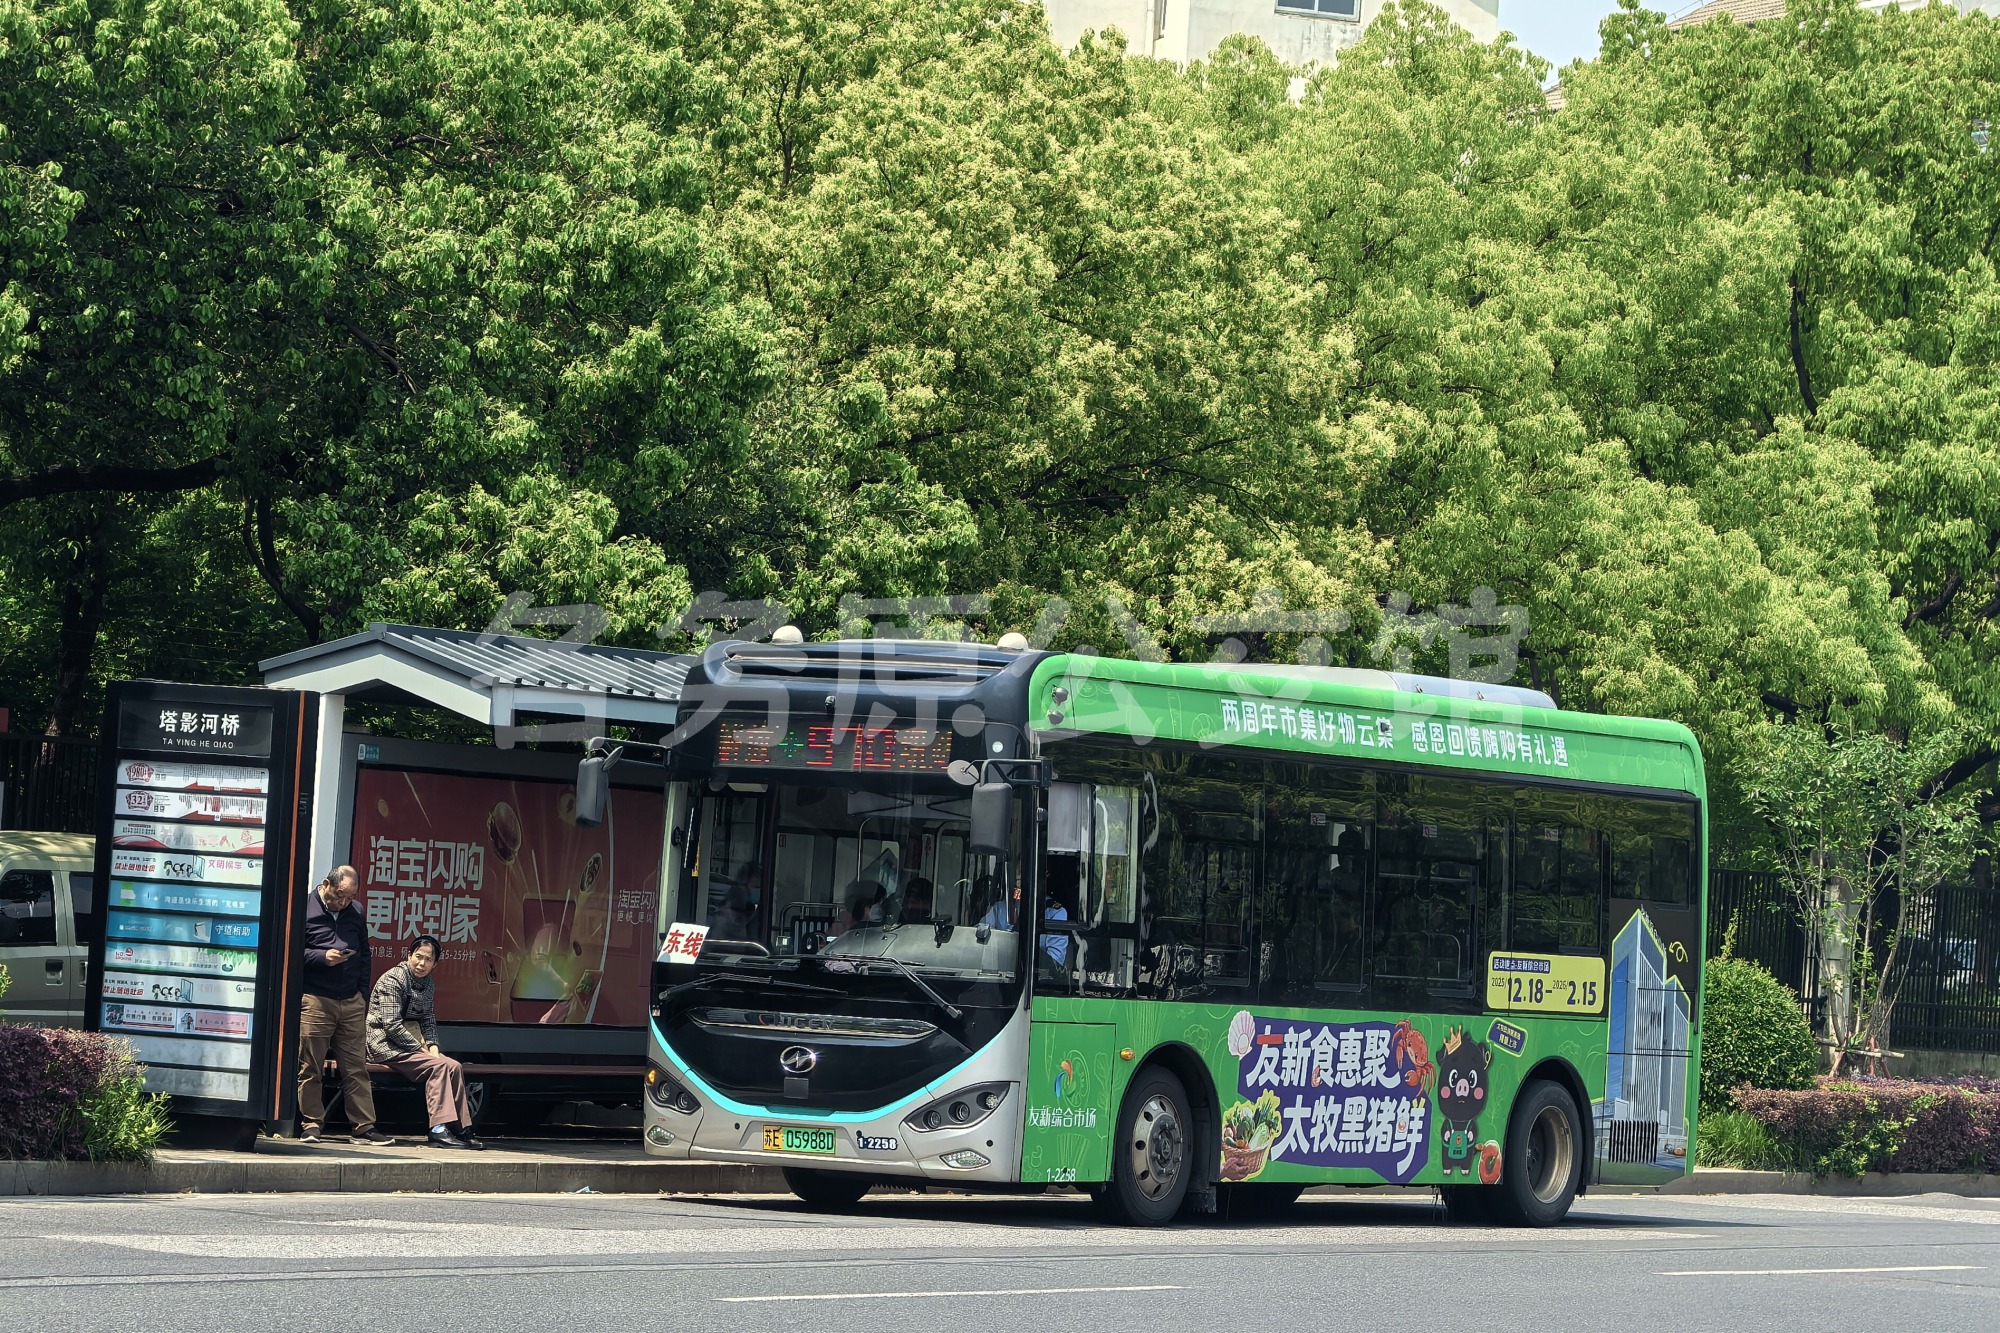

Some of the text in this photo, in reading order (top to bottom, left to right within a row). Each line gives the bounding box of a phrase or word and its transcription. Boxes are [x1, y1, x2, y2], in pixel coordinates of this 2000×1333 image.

[158, 709, 240, 737] 塔影河桥
[1220, 698, 1568, 767] 两周年市集好物云集 感恩回馈嗨购有礼遇
[162, 737, 234, 749] TA YING HE QIAO
[208, 859, 243, 870] 文明候车
[367, 836, 484, 891] 淘宝闪购
[215, 924, 251, 937] 守望相助
[366, 890, 480, 944] 更快到家
[662, 929, 704, 958] 东线
[1246, 1025, 1401, 1089] 友新食惠聚
[1028, 1105, 1097, 1128] 友新综合市场
[1270, 1094, 1426, 1177] 太牧黑猪鲜
[1046, 1167, 1076, 1183] 1-2258
